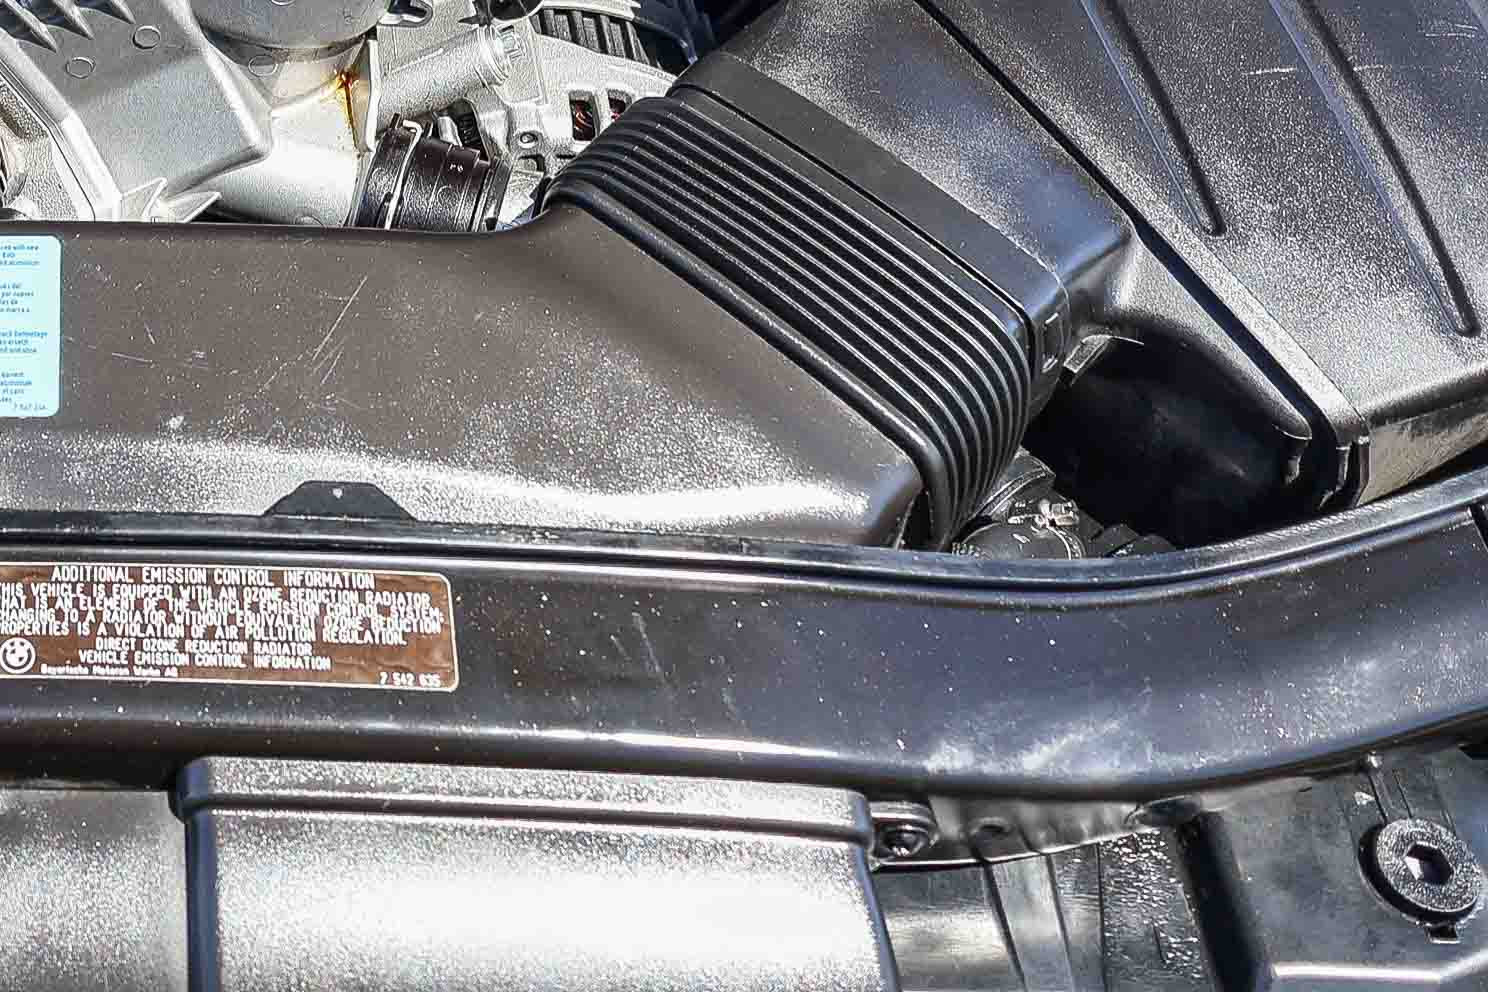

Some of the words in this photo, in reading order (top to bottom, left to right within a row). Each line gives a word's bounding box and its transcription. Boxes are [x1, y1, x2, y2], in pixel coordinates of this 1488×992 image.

[51, 566, 134, 582] ADDITIONAL
[142, 568, 207, 584] EMISSION
[214, 569, 274, 586] CONTROL
[283, 570, 375, 590] INFORMATION
[31, 583, 85, 597] VEHICLE
[93, 584, 105, 597] IS
[112, 583, 172, 600] EQUIPPED
[179, 586, 212, 600] WITH
[219, 587, 237, 600] AN
[243, 587, 282, 601] OZONE
[290, 588, 359, 604] REDUCTION
[366, 592, 431, 607] RADIATOR
[36, 597, 48, 609] IS
[55, 597, 72, 609] AN
[79, 596, 136, 610] ELEMENT
[143, 599, 158, 612] OF
[168, 599, 189, 612] THE
[199, 600, 251, 613] VEHICLE
[259, 602, 320, 616] EMISSION
[326, 604, 378, 618] CONTROL
[65, 610, 79, 622] TO
[86, 609, 95, 623] A
[103, 610, 166, 624] RADIATOR
[174, 611, 228, 626] WITHOUT
[238, 612, 316, 628] EQUIVALENT
[323, 616, 364, 630] OZONE
[372, 618, 441, 633] REDUCTION
[77, 623, 90, 635] IS
[97, 624, 107, 635] A
[115, 624, 184, 638] VIOLATION
[191, 625, 207, 638] OF
[215, 625, 239, 639] AIR
[245, 626, 316, 642] POLLUTION
[95, 637, 136, 650] DIRECT
[142, 640, 178, 652] OZONE
[185, 640, 248, 654] REDUCTION
[254, 642, 312, 655] RADIATOR
[79, 649, 128, 664] VEHICLE
[134, 651, 189, 666] EMISSION
[195, 654, 247, 668] CONTROL
[254, 655, 331, 671] INFORMATION
